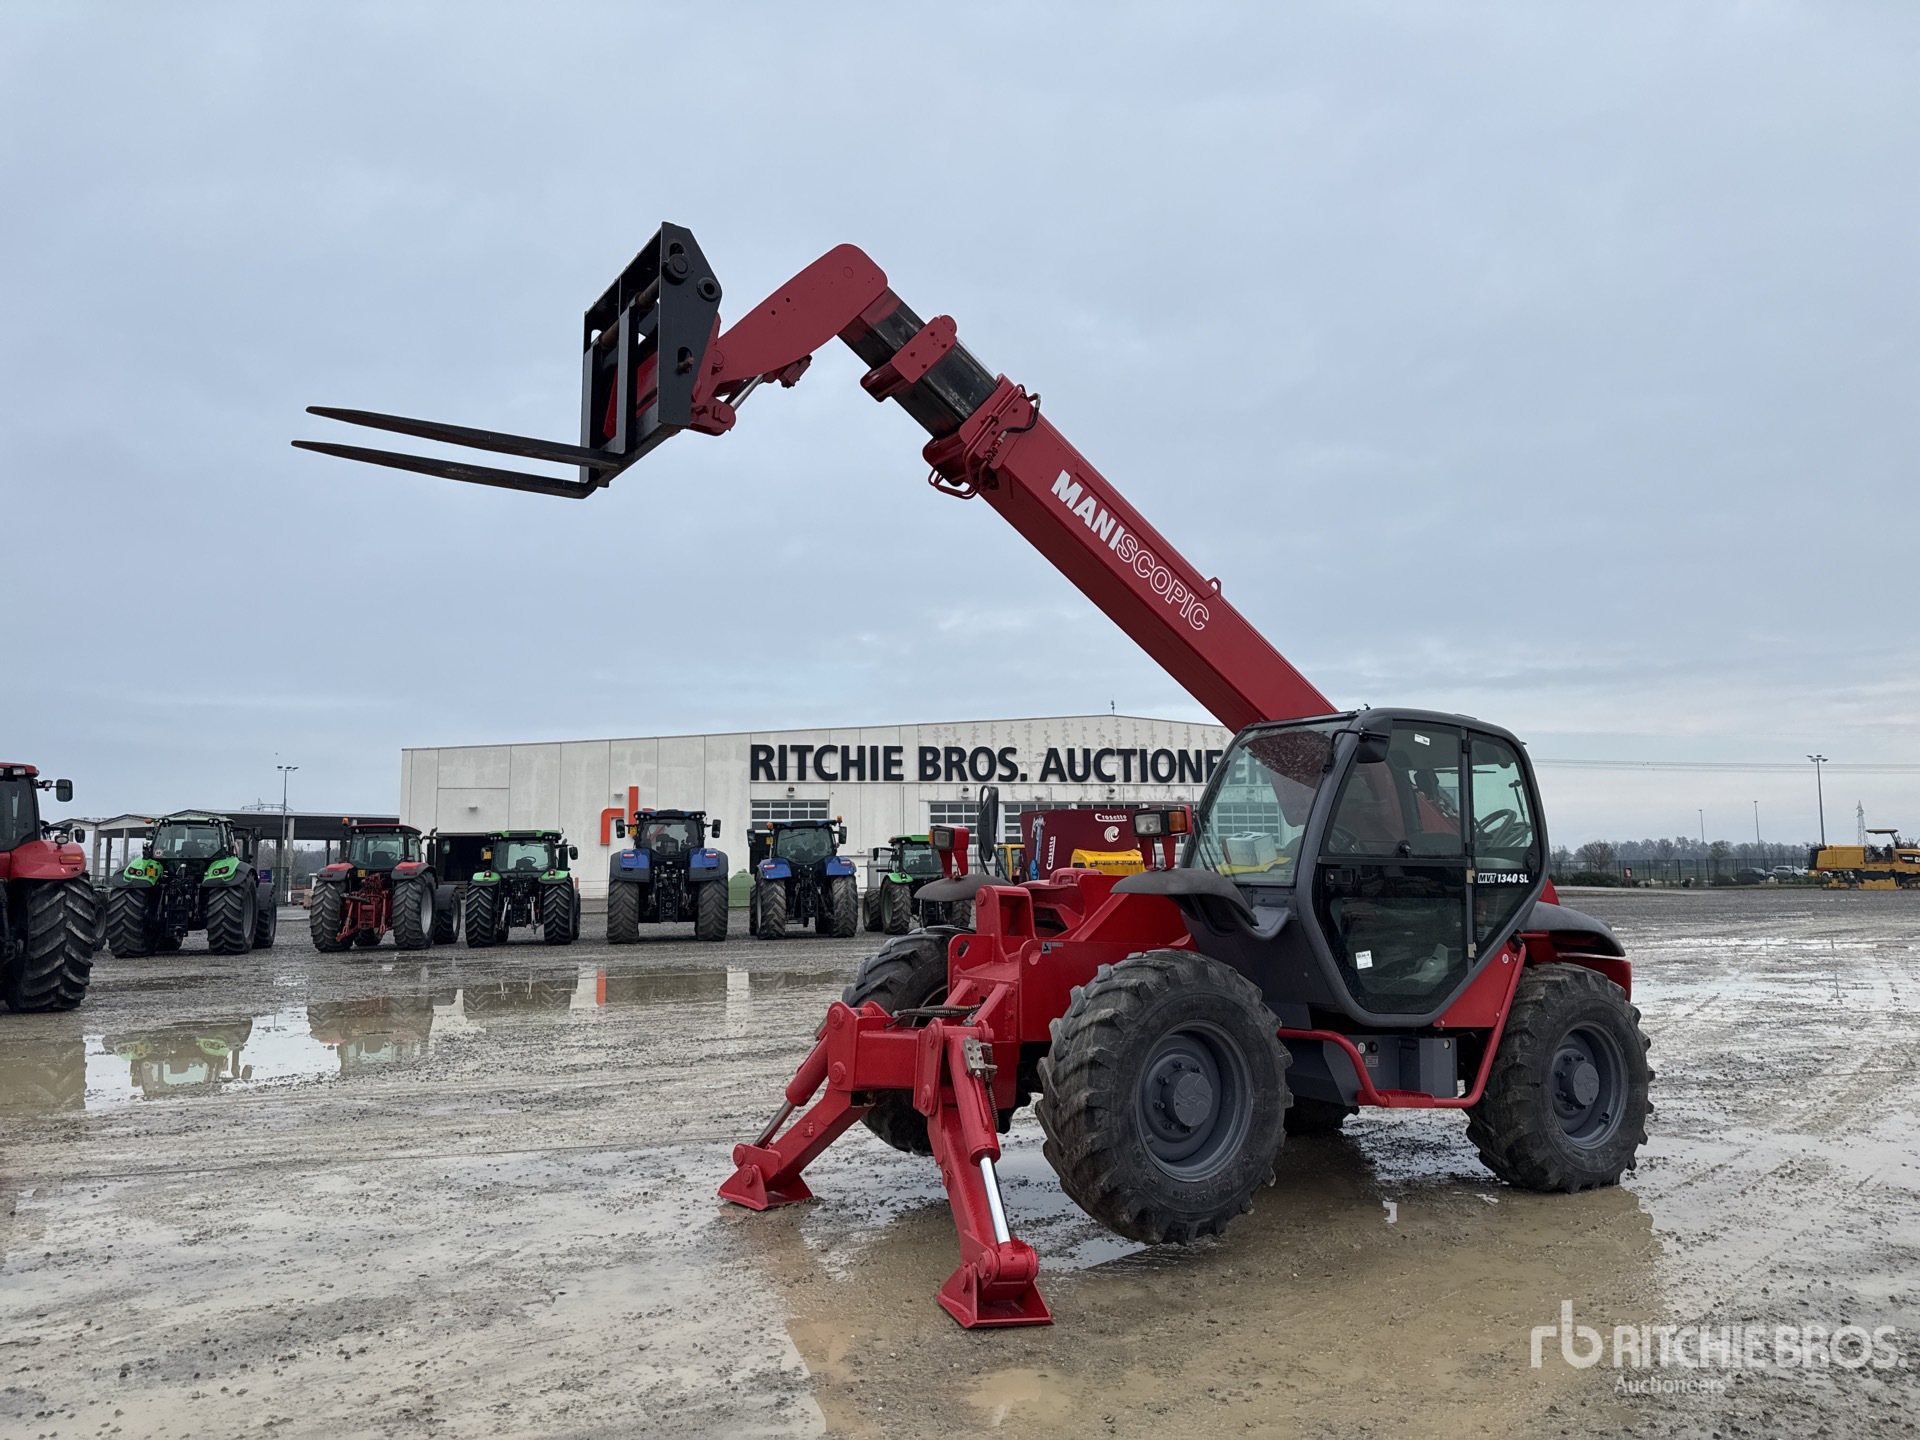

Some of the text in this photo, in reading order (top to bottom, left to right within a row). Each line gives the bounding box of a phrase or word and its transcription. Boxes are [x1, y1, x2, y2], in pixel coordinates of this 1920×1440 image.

[1051, 469, 1209, 630] MANISCOPIC
[750, 745, 904, 782] RITCHIE
[918, 746, 1027, 783] BROS.
[1094, 813, 1128, 823] Crosetto
[1046, 835, 1057, 870] Crosetto
[1478, 873, 1529, 884] MVT 1340 SL
